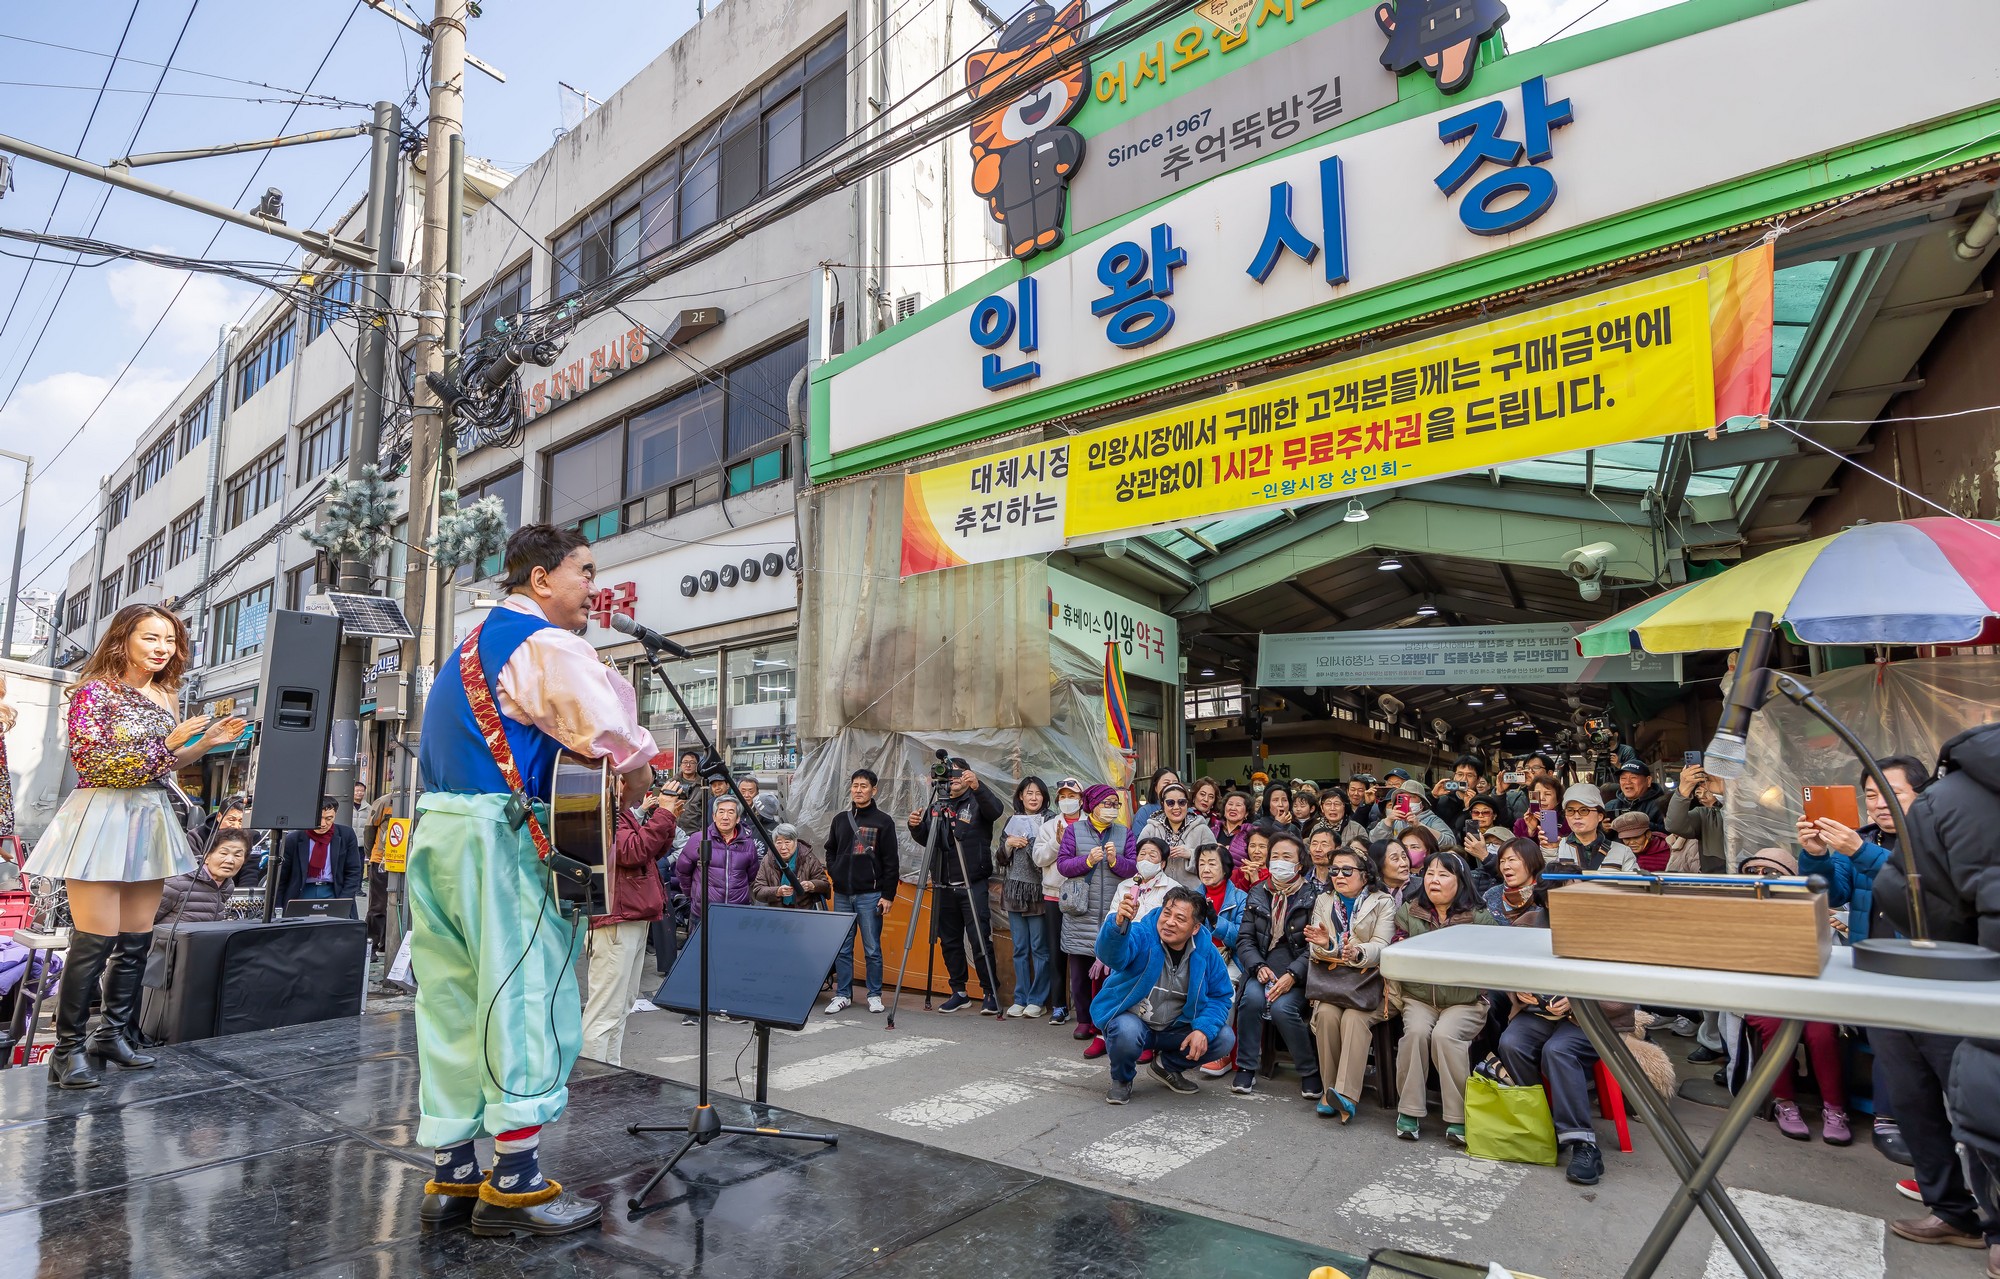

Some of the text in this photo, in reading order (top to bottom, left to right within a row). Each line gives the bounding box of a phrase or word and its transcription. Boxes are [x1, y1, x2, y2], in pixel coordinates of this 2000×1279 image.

[1160, 76, 1343, 182] 추억뚝방길
[969, 74, 1574, 392] 인왕시장
[692, 312, 705, 323] 2F
[552, 357, 586, 400] 자재
[590, 325, 649, 383] 전시장
[1088, 306, 1672, 471] 인왕시장에서 구매한 고객분들께는 구매금액에
[1115, 374, 1616, 503] 상관없이 1시간 무료주차권을 드립니다.
[954, 492, 1058, 538] 추진하는
[1063, 603, 1165, 664] 휴베이스 인왕약국
[763, 752, 797, 769] 안녕하세요
